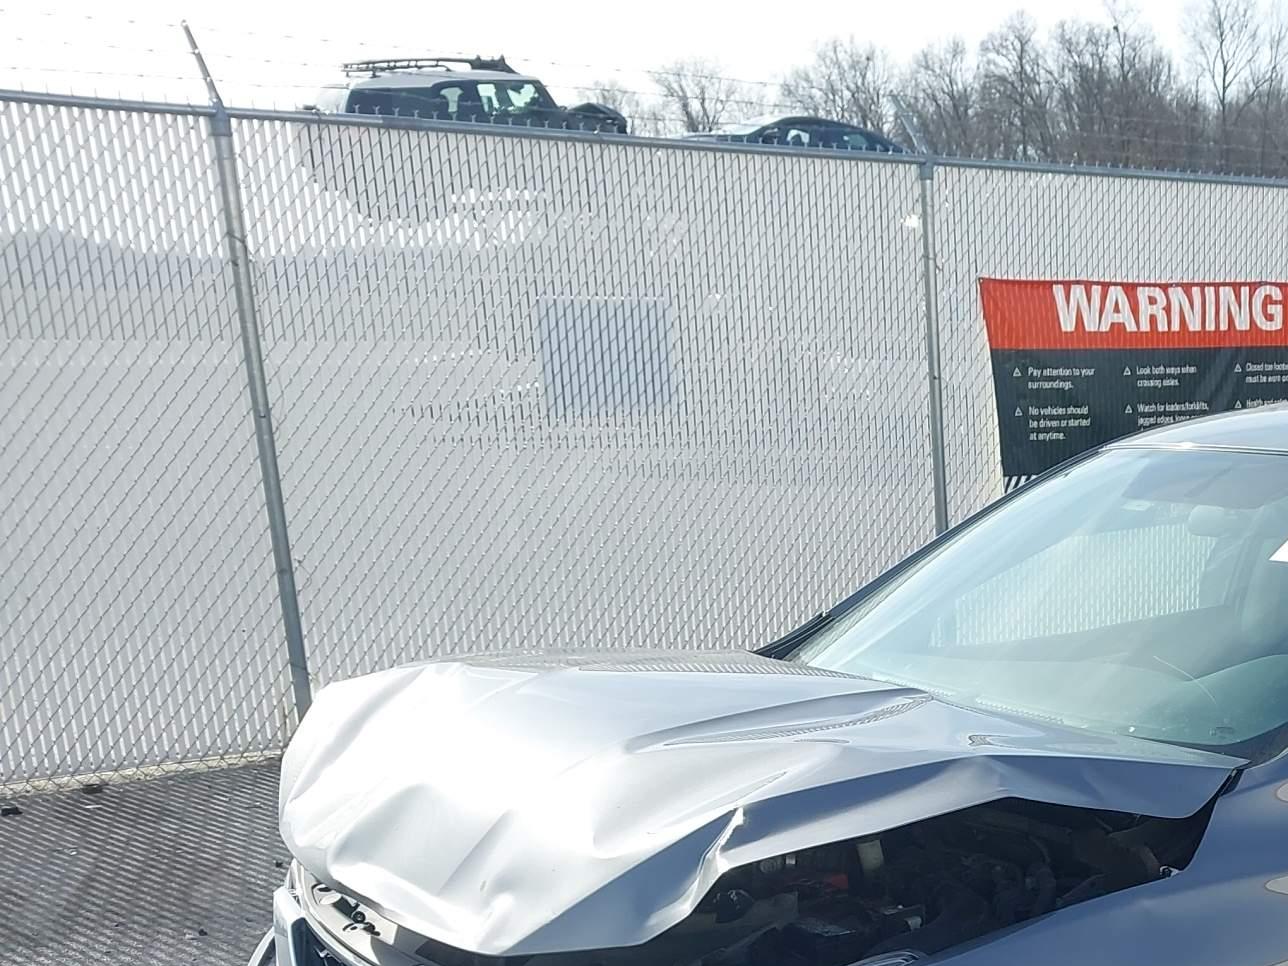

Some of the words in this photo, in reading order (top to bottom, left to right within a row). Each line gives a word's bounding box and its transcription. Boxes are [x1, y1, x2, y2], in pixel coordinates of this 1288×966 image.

[1053, 284, 1283, 332] WARNING
[1043, 366, 1072, 376] attention
[1073, 368, 1080, 376] to
[1081, 368, 1095, 377] your
[1136, 365, 1151, 375] Look
[1152, 364, 1165, 374] both
[1028, 379, 1074, 390] surroundings.
[1137, 378, 1161, 388] crossing
[1029, 406, 1039, 415] No
[1040, 405, 1066, 415] vehicles
[1067, 405, 1088, 415] should
[1137, 403, 1156, 413] Watch
[1157, 402, 1165, 412] for
[1029, 418, 1038, 428] be
[1039, 418, 1060, 428] driven
[1068, 417, 1091, 426] started
[1029, 432, 1037, 440] at
